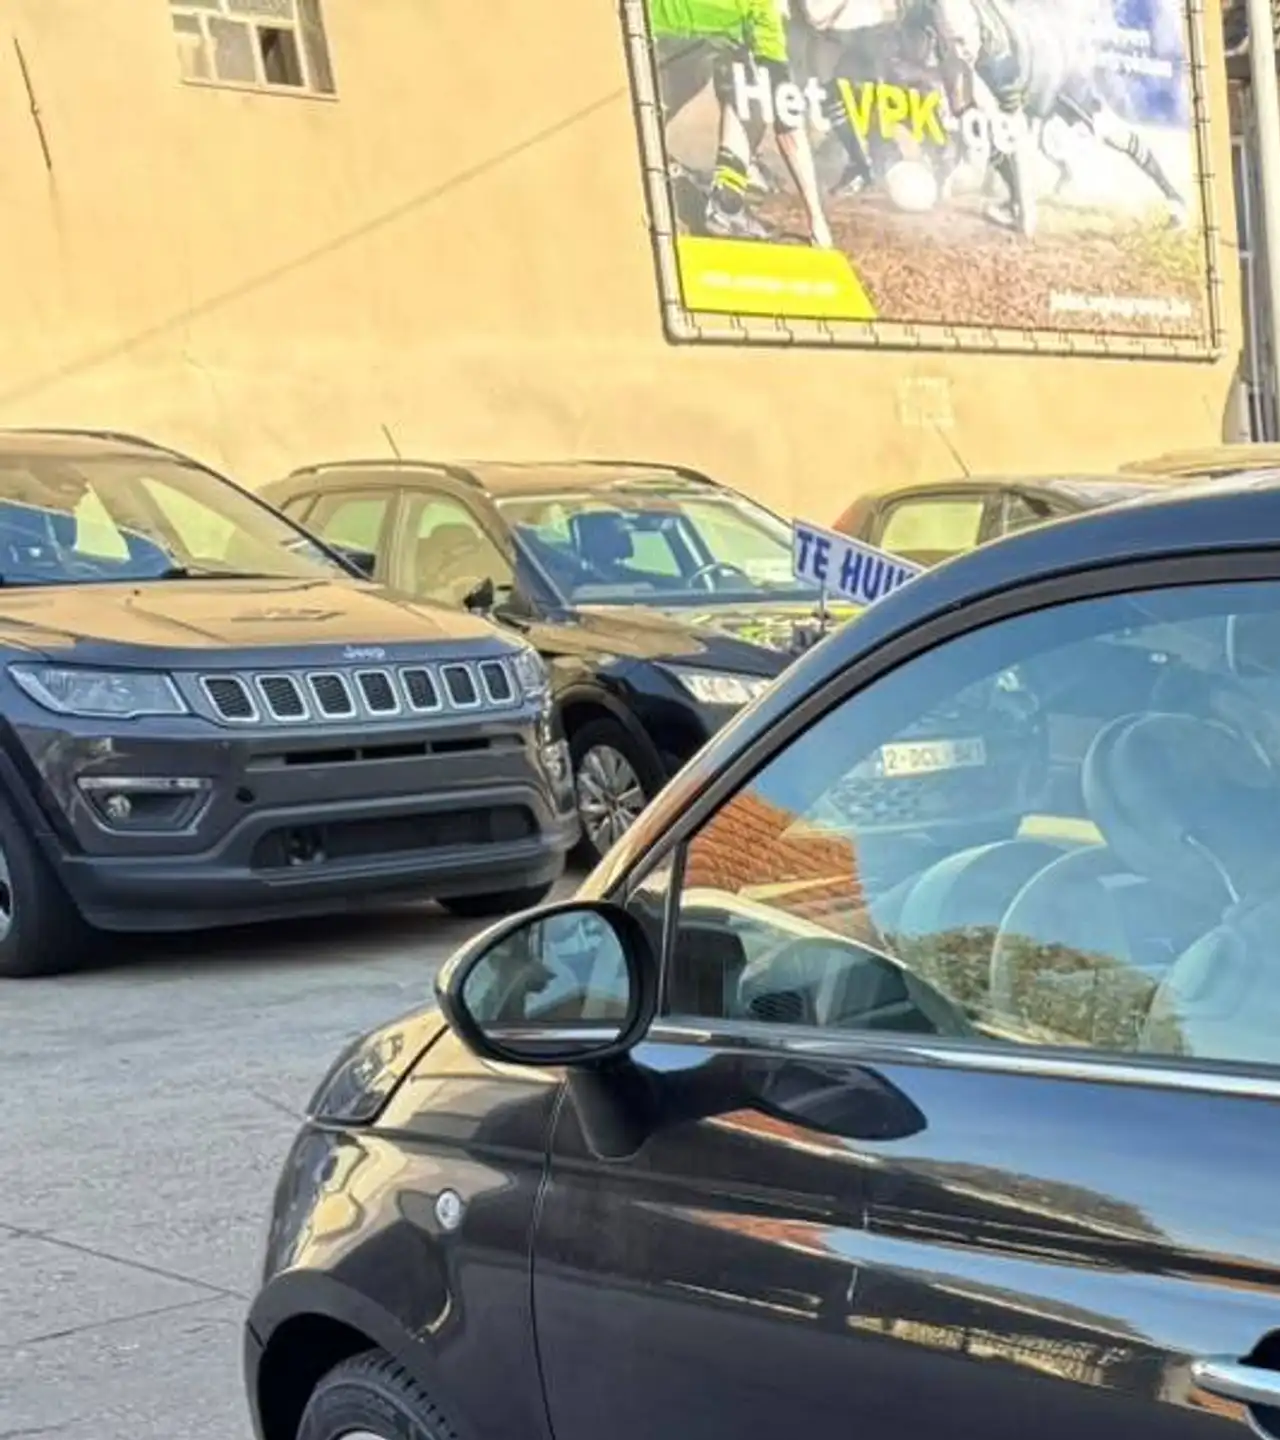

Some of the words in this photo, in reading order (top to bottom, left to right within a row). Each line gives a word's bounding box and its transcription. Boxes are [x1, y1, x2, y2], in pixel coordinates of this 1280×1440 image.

[732, 62, 831, 132] Het
[797, 528, 831, 580] TE
[840, 548, 914, 600] HUU
